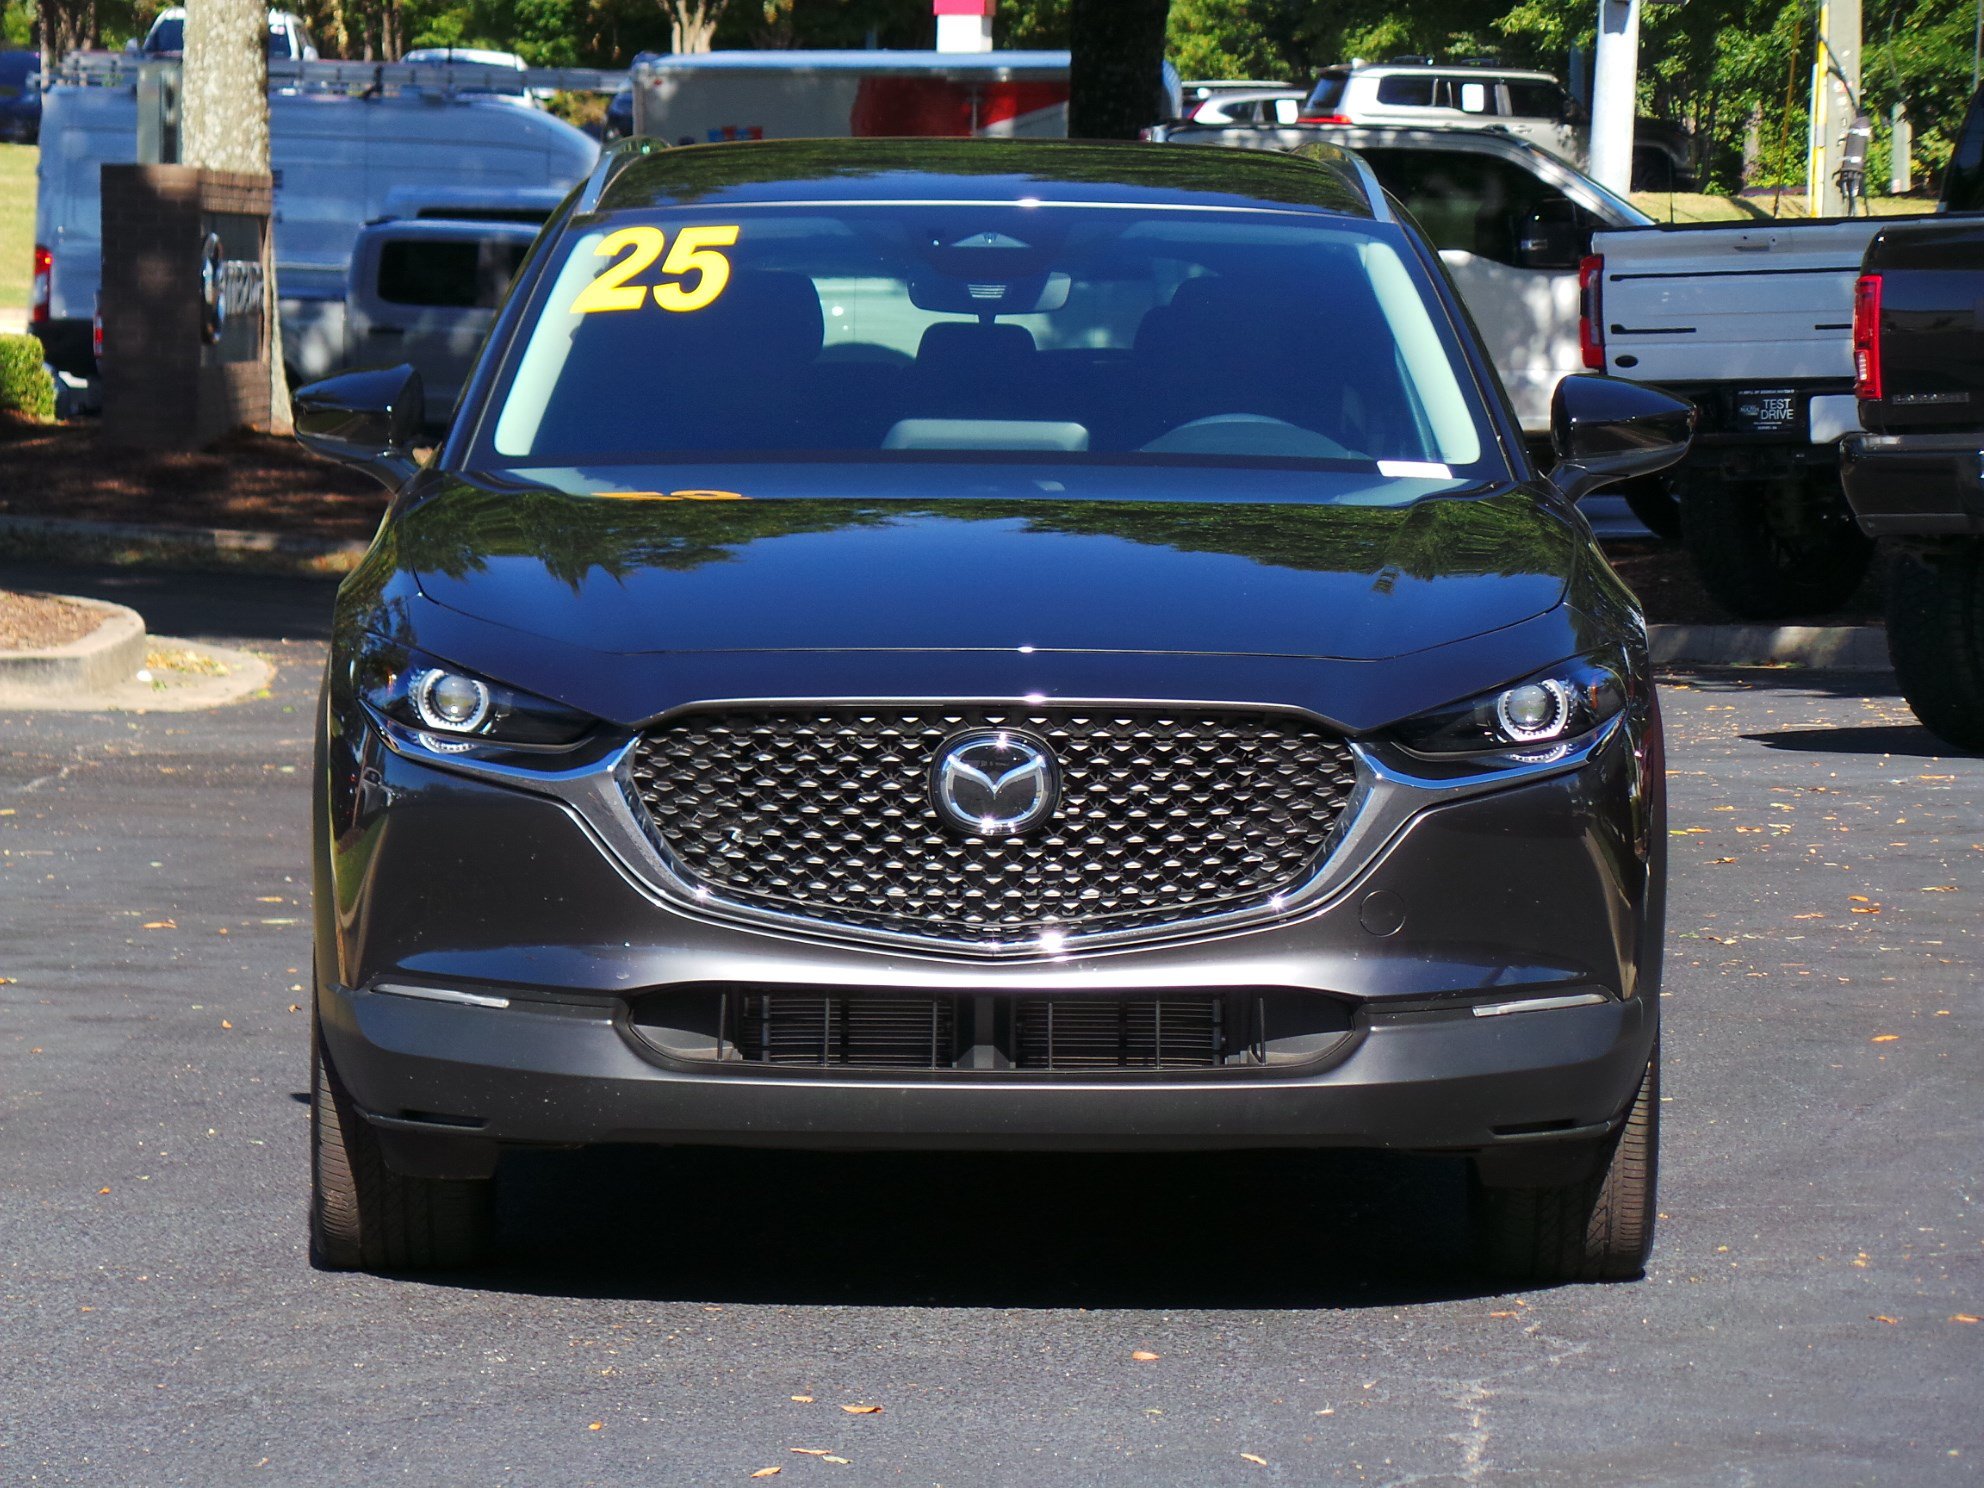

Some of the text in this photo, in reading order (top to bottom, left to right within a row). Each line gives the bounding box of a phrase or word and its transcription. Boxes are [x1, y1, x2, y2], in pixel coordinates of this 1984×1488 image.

[569, 225, 740, 314] 25
[1763, 398, 1792, 409] TEST
[1761, 409, 1795, 420] DRIVE
